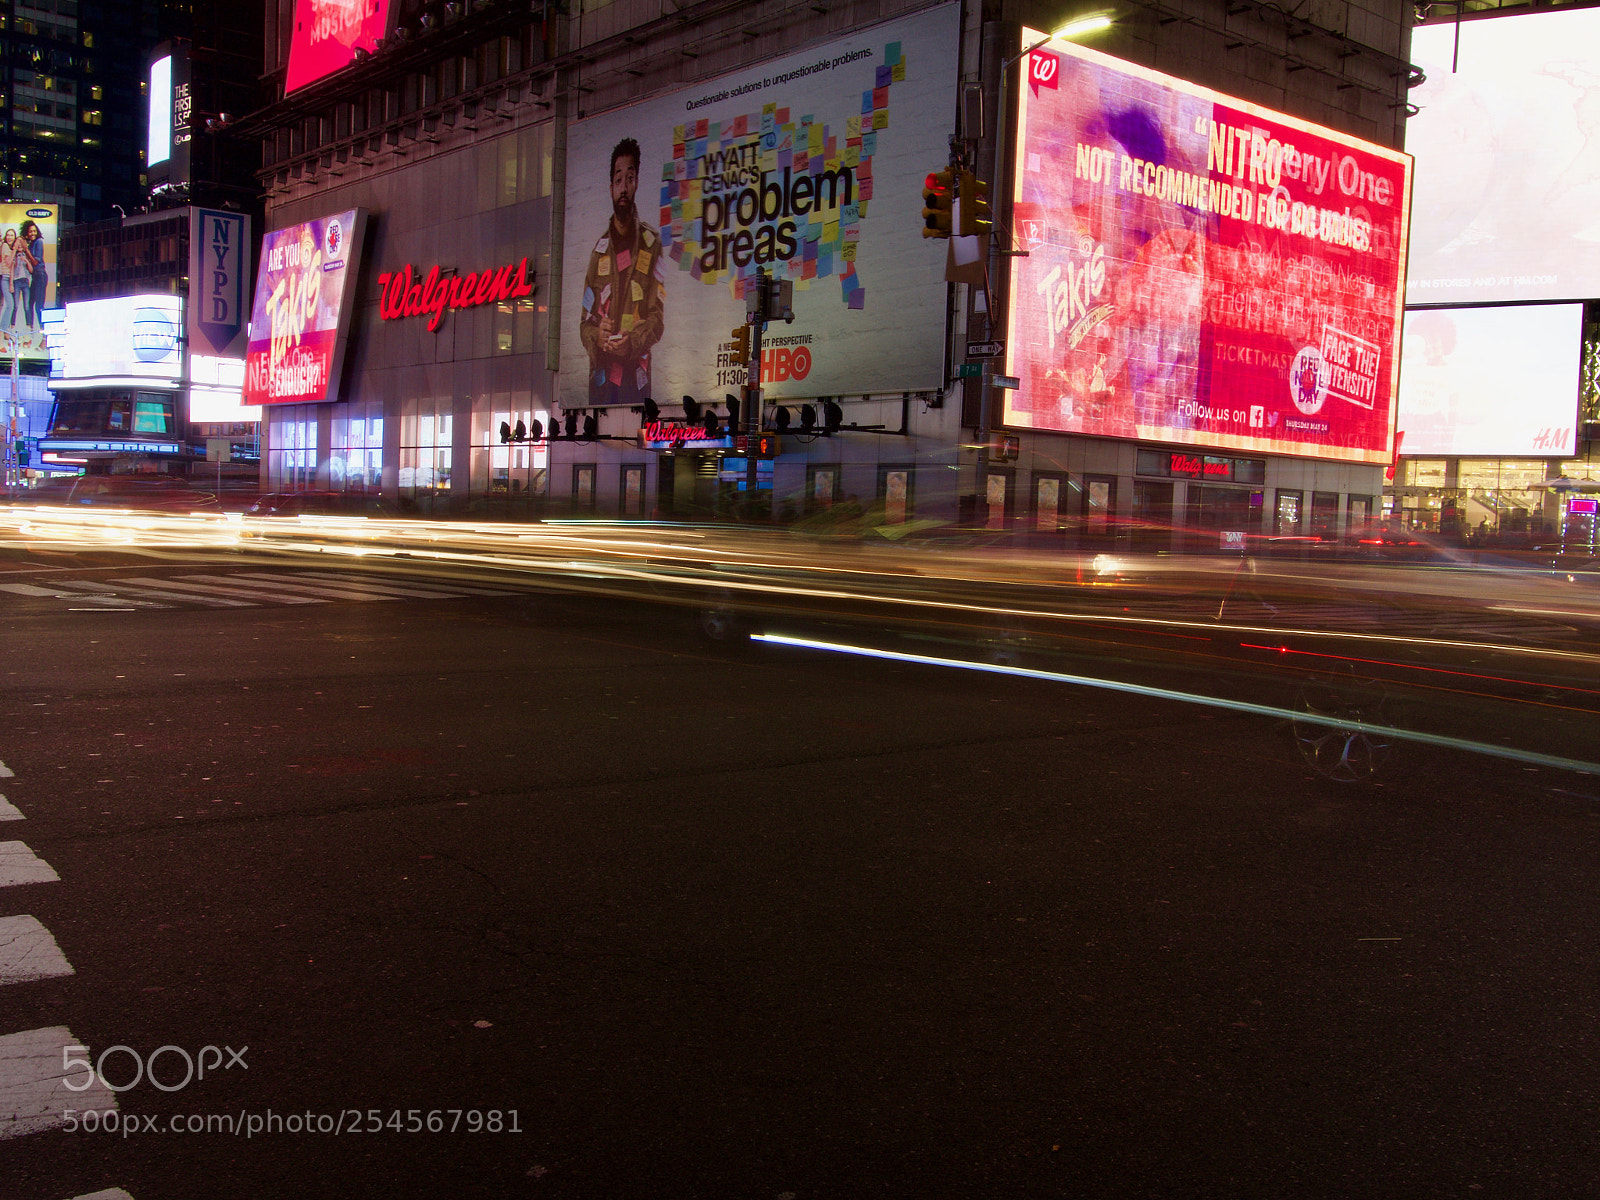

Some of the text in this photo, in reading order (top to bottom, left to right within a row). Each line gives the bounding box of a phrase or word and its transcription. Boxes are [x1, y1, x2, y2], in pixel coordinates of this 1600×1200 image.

[310, 0, 374, 46] MUSICAL
[174, 83, 189, 99] THE
[686, 47, 874, 111] Questionable solutions to unquestionable problems.
[174, 96, 192, 113] FIRST
[702, 142, 760, 175] WYATT
[702, 165, 760, 194] CENAC'S
[1075, 143, 1116, 186] NOT
[1119, 154, 1253, 222] RECOMMENDED
[701, 166, 853, 249] problem
[268, 242, 301, 273] ARE YOU
[700, 220, 798, 274] areas
[212, 218, 231, 322] NYPD
[378, 257, 534, 332] Walgreens
[771, 334, 814, 347] PERSPECTIVE
[971, 345, 1000, 354] ONE WAY
[1323, 333, 1377, 377] FACE THE
[760, 345, 812, 384] HBO
[1321, 360, 1374, 400] INTENSITY
[1177, 398, 1214, 420] Follow
[1216, 407, 1230, 421] us
[1232, 409, 1246, 424] on
[1531, 427, 1571, 450] H&M
